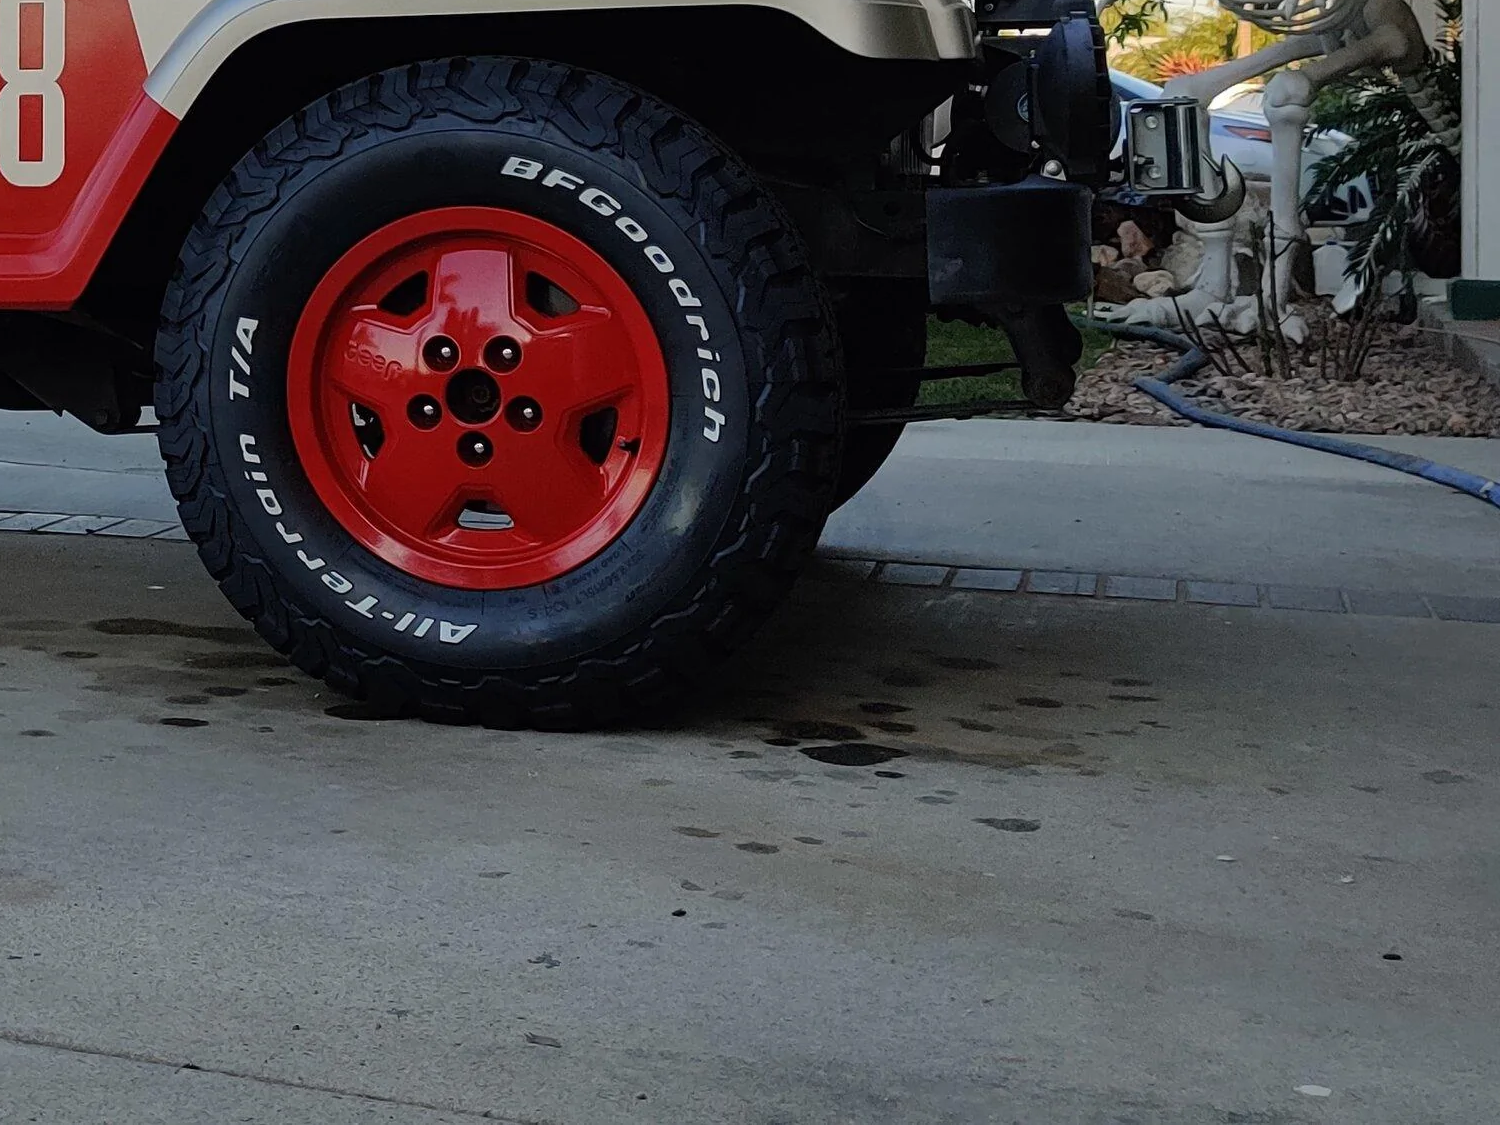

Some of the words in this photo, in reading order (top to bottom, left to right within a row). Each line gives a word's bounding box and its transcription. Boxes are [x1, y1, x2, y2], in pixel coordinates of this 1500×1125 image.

[229, 317, 259, 402] T/A
[500, 155, 727, 444] BFGoodrich
[244, 432, 479, 645] All-Terrain
